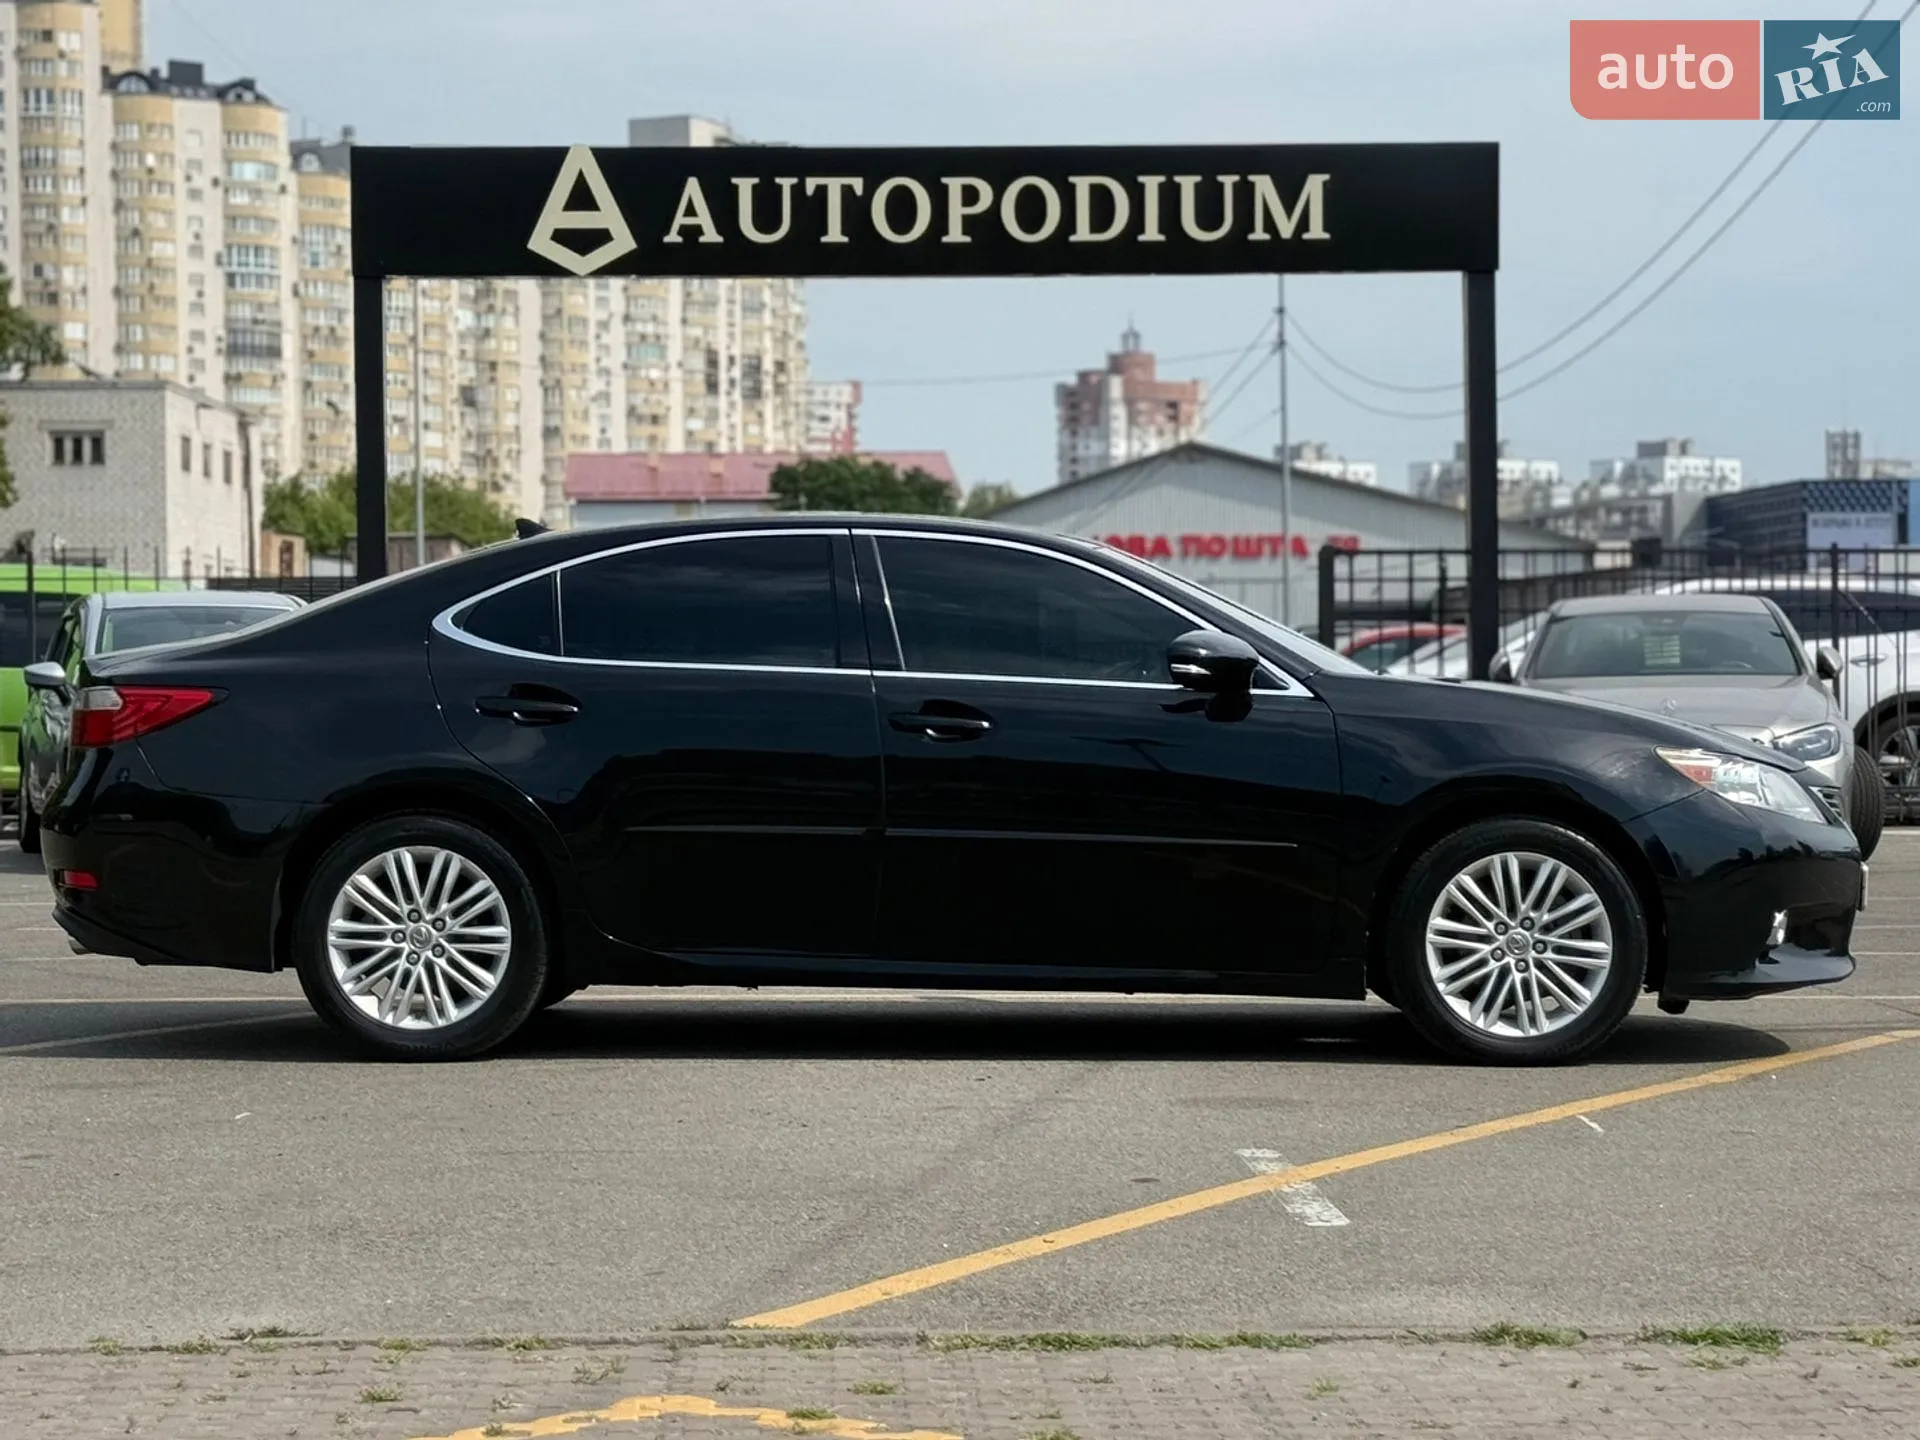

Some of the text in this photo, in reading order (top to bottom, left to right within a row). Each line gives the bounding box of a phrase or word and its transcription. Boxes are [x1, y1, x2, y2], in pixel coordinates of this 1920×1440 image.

[662, 173, 1332, 244] AUTOPODIUM
[1094, 531, 1174, 559] ОВА
[1181, 531, 1310, 559] ПОШТА
